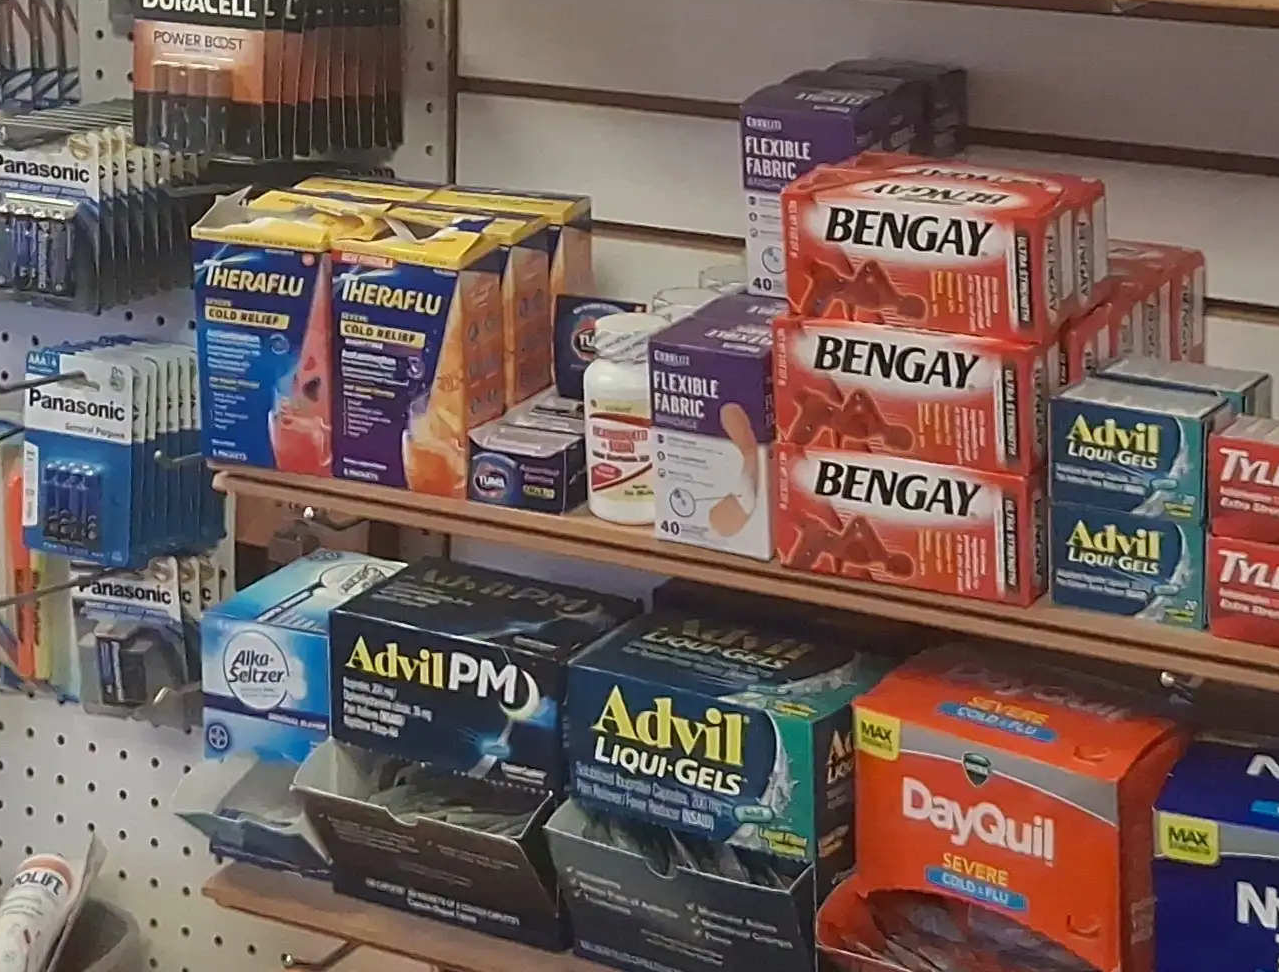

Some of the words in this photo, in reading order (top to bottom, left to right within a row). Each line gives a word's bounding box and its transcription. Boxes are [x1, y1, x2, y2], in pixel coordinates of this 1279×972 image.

[152, 29, 202, 49] POWER
[204, 33, 245, 51] BOOST
[745, 136, 811, 162] FLEXIBLE
[745, 157, 798, 182] FABRIC
[825, 206, 994, 258] BENGAY
[203, 263, 304, 298] THERAFLU
[752, 277, 773, 293] 40
[339, 273, 444, 316] THERAFLU
[208, 309, 237, 321] COLD
[240, 312, 280, 326] RELIEF
[344, 323, 373, 337] COLD
[376, 329, 416, 344] RELIEF
[27, 353, 48, 367] AAA
[813, 335, 981, 390] BENGAY
[652, 370, 720, 401] FLEXIBLE
[27, 386, 126, 422] Panasonic
[652, 394, 707, 420] FABRIC
[1066, 414, 1162, 455] Advil
[478, 473, 506, 489] TUMS
[814, 460, 983, 517] BENGAY
[1220, 497, 1252, 512] Extra
[659, 520, 681, 536] 40
[1066, 519, 1162, 561] Advil
[78, 579, 173, 606] Panasonic
[1220, 598, 1252, 614] Extra
[232, 649, 274, 667] Alka-
[344, 634, 446, 690] Advil
[447, 650, 518, 704] PM
[227, 667, 285, 684] Seltzer
[966, 696, 1050, 726] SEVERE
[592, 685, 750, 768] Advil
[860, 719, 894, 745] MAX
[902, 776, 1056, 862] DayQuil
[1167, 825, 1210, 848] MAX
[942, 852, 1009, 886] SEVERE
[941, 869, 976, 894] COLD
[985, 883, 1010, 906] FLU
